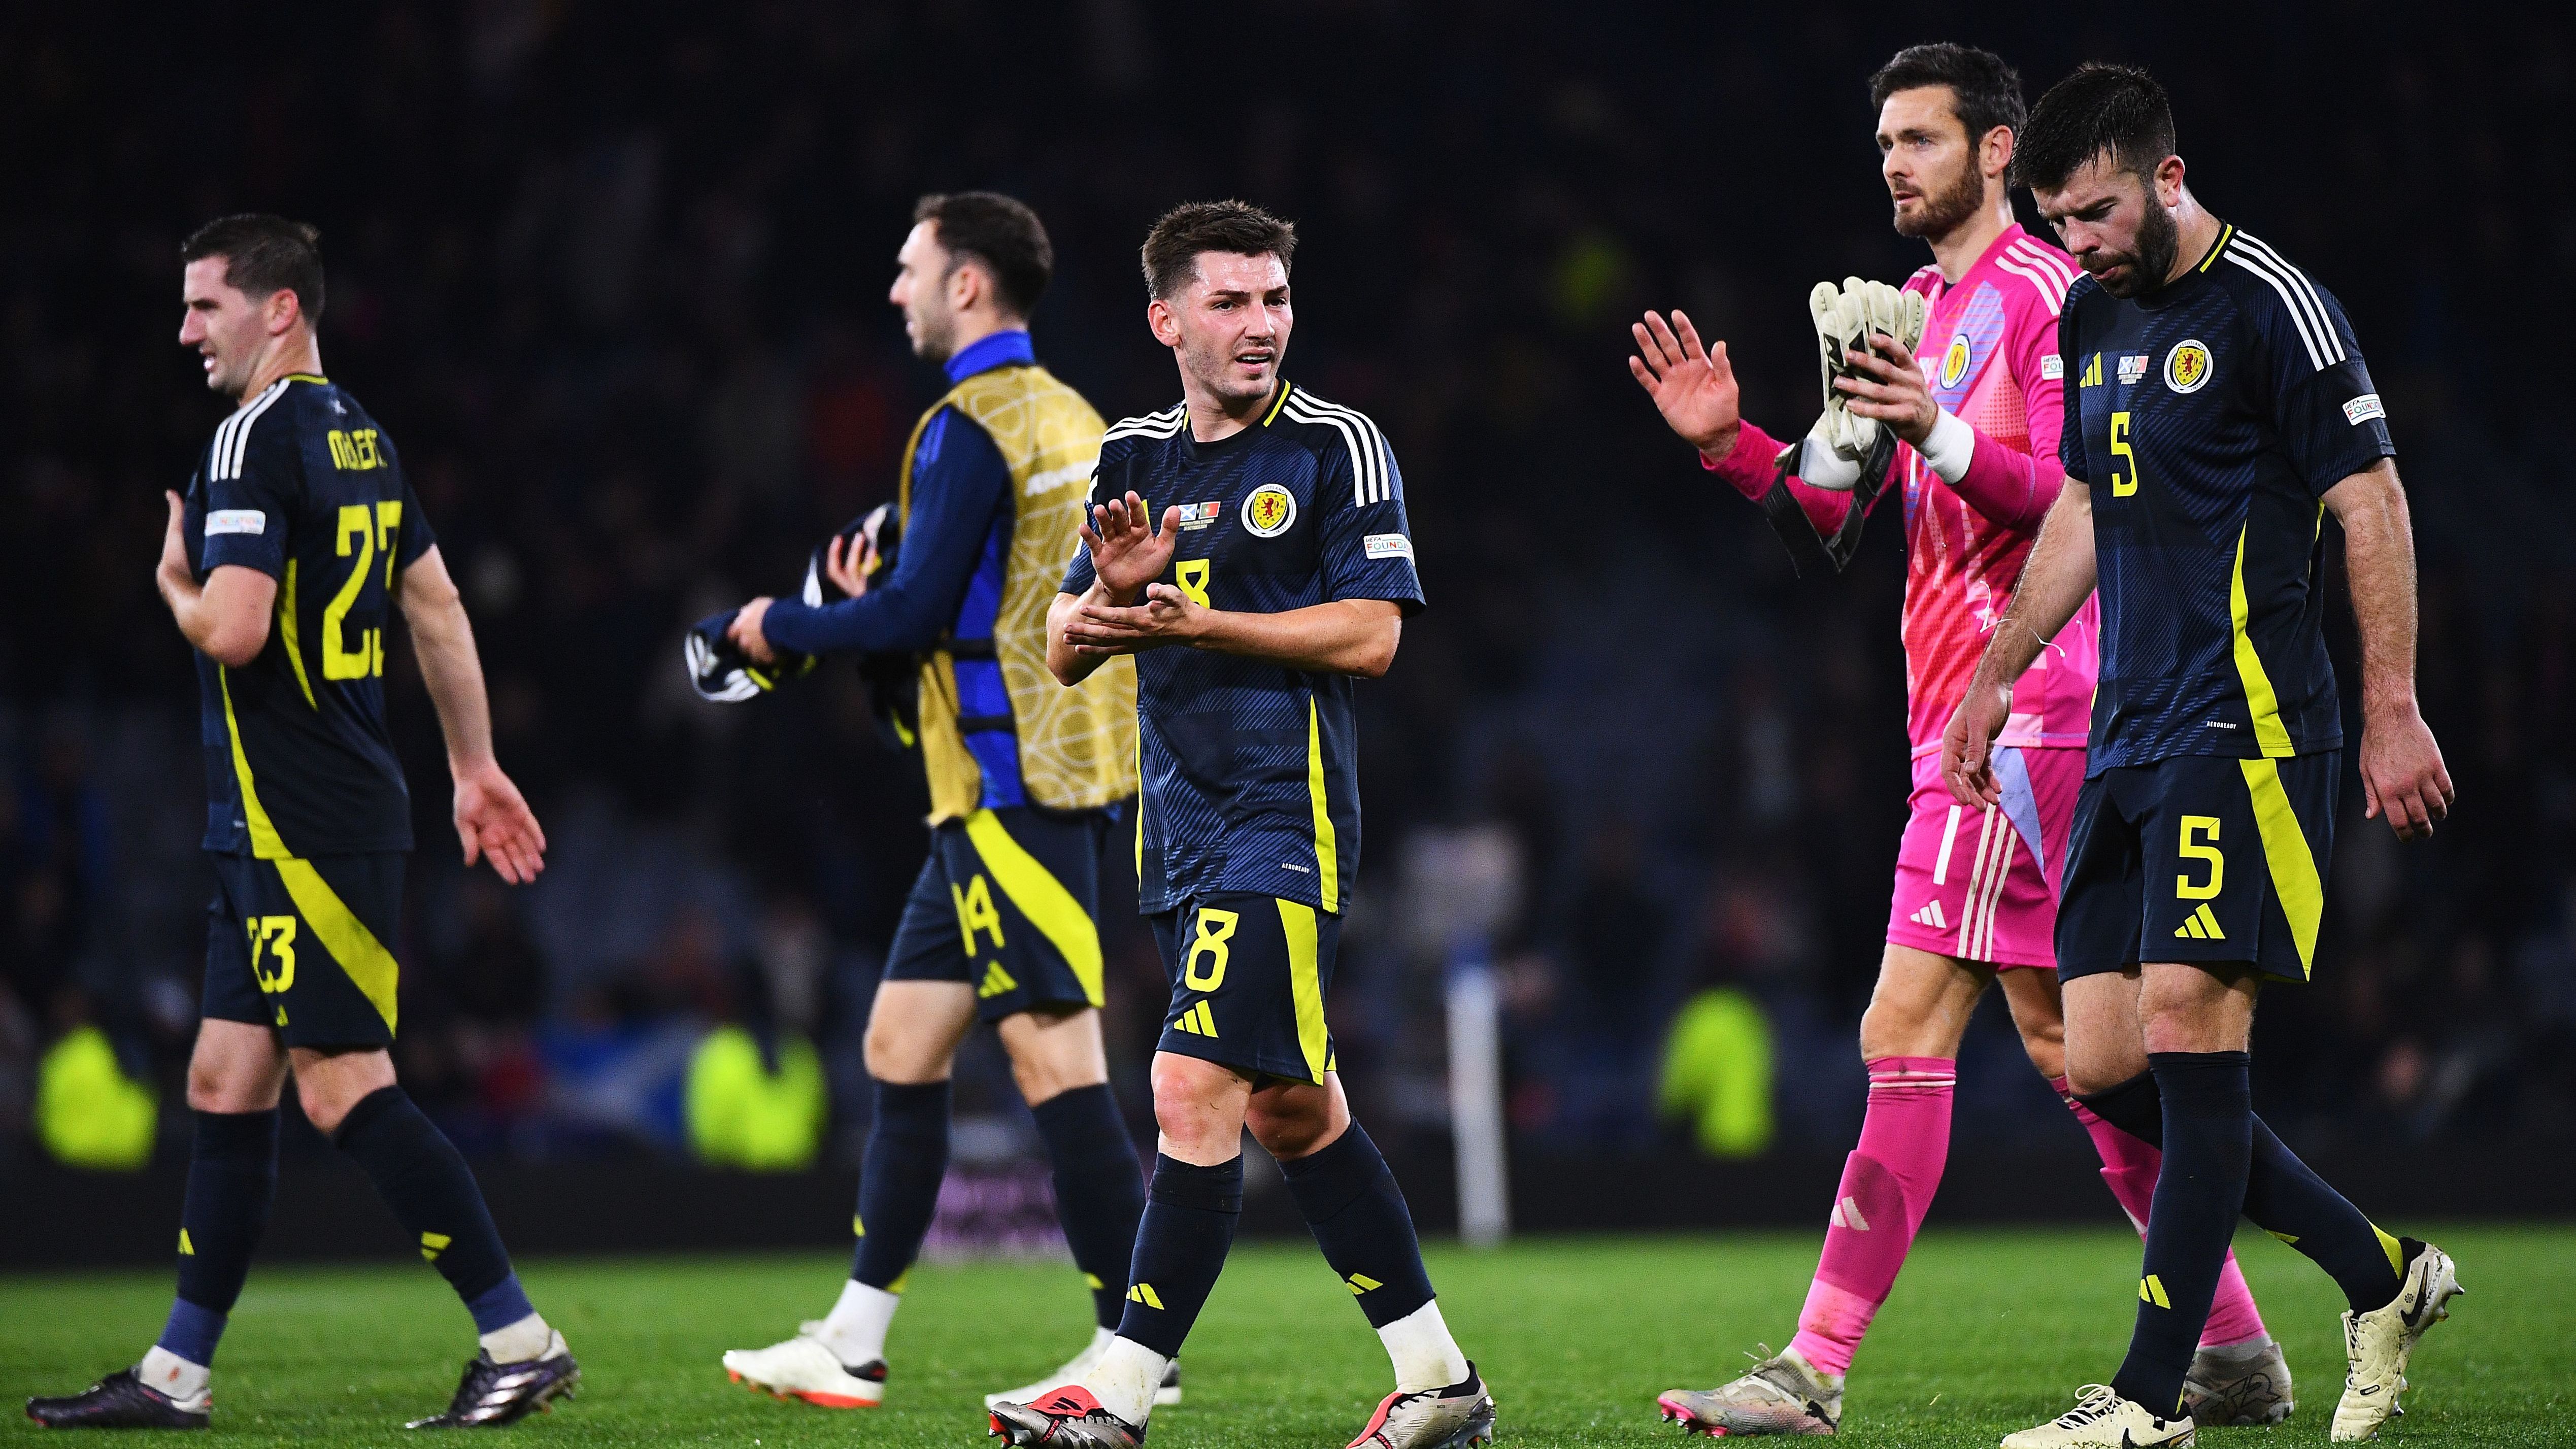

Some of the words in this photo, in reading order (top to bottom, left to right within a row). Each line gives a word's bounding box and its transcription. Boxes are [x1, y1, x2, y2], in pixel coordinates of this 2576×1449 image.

[2182, 341, 2203, 349] SCOTLAND
[2345, 399, 2360, 410] UEFA
[2110, 411, 2138, 497] 5
[2206, 721, 2236, 730] AEROREADY
[1281, 862, 1310, 874] AEROREADY
[1933, 805, 1961, 885] 1
[2176, 815, 2225, 900] 5
[246, 915, 296, 994] 23
[951, 873, 1005, 958] 14
[1184, 907, 1239, 992] 8
